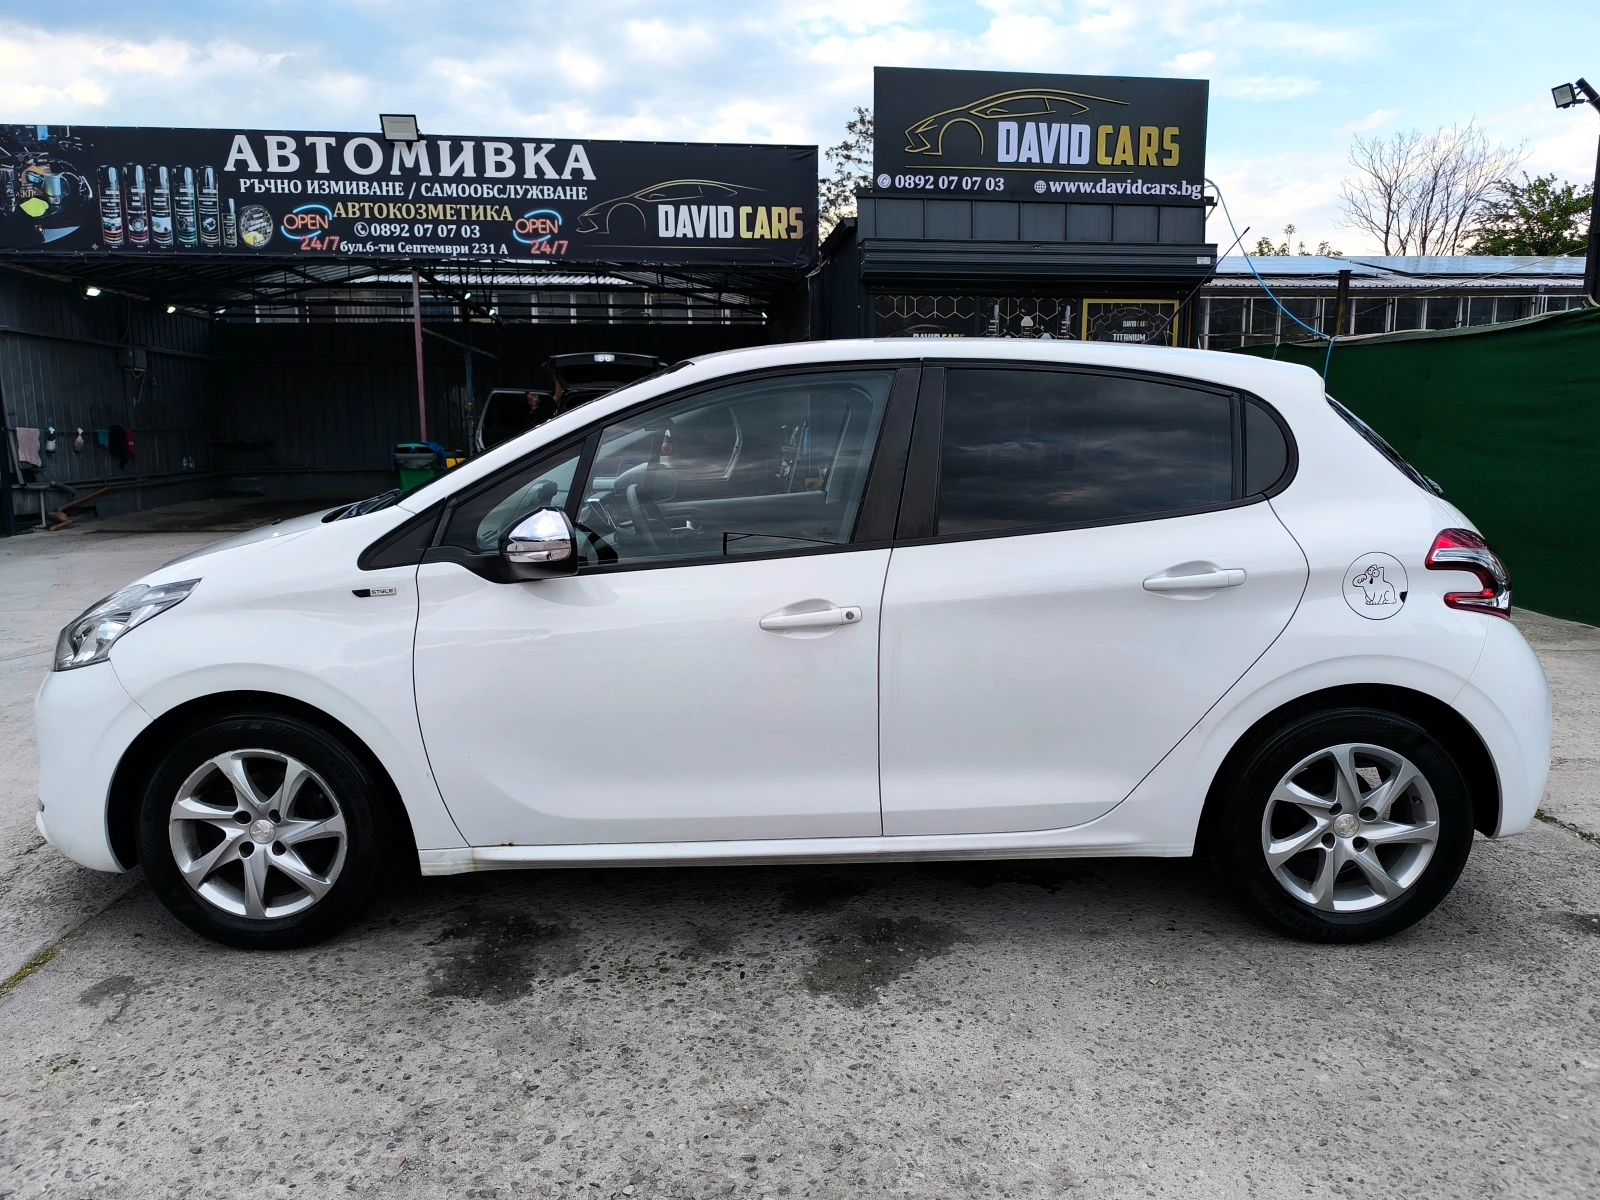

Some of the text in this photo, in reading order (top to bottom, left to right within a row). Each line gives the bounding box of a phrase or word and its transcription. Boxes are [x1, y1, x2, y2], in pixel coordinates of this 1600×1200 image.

[997, 121, 1180, 167] DAVID CARS
[223, 134, 597, 180] АВТОМИВКА
[239, 178, 302, 194] РЪЧНО
[306, 180, 404, 196] ИЗМИВАНЕ
[421, 182, 588, 200] САМООБСЛУЖВАНЕ
[895, 174, 1005, 191] 0892 07 07 03
[1049, 178, 1203, 200] www.davidcars.bg
[333, 202, 513, 221] АВТОКОЗМЕТИКА
[283, 213, 329, 230] OPEN
[515, 218, 559, 234] OPEN
[658, 204, 804, 240] DAVID CARS
[370, 223, 481, 238] 0892 07 07 03
[300, 236, 340, 251] 24/7
[340, 240, 395, 254] бул.6-ти
[398, 242, 469, 257] Септември
[472, 243, 496, 255] 231
[530, 240, 569, 255] 24/7
